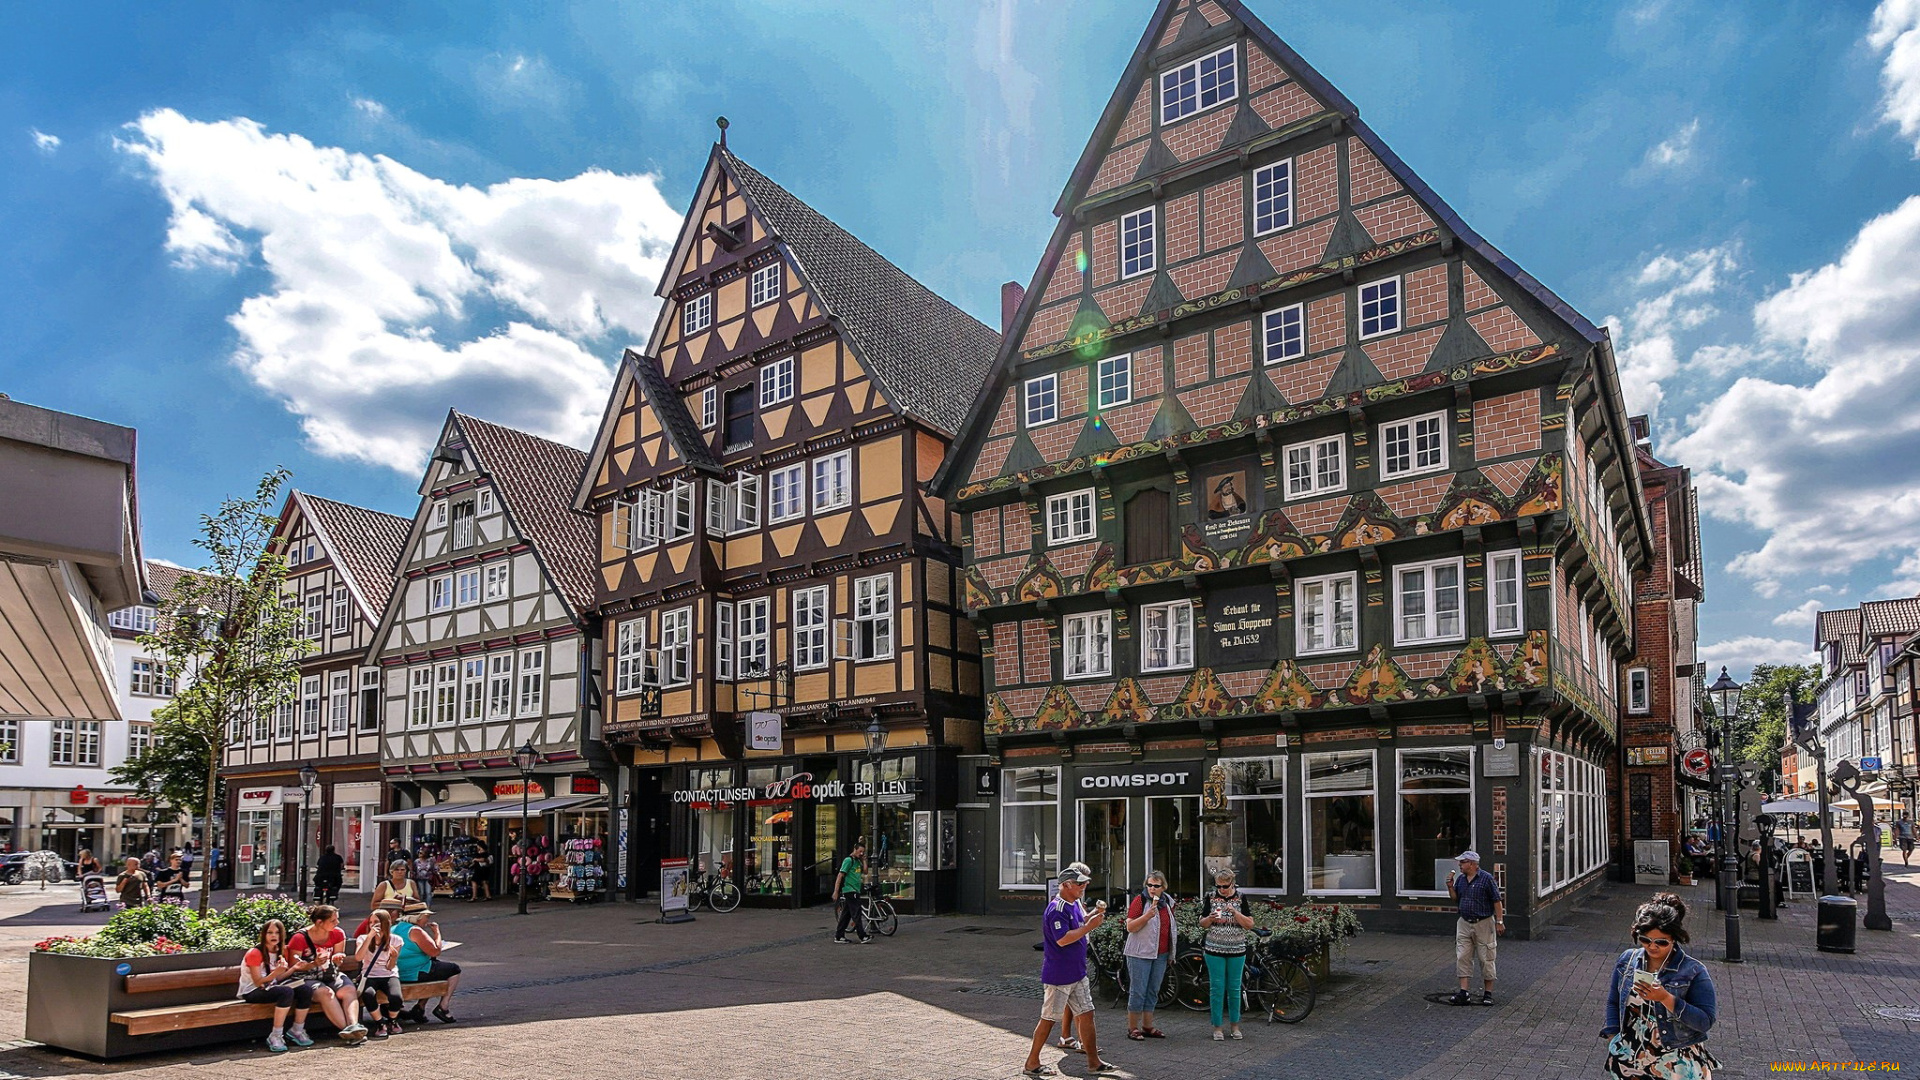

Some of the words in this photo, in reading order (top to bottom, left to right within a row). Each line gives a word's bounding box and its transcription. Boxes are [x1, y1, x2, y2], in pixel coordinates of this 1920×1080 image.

[1213, 621, 1236, 633] Simon
[1243, 633, 1260, 645] 1532
[1081, 772, 1190, 789] COMSPOT
[673, 787, 756, 804] CONTACTLINSEN
[791, 782, 811, 799] die
[811, 780, 846, 803] optik
[624, 794, 630, 804] 7
